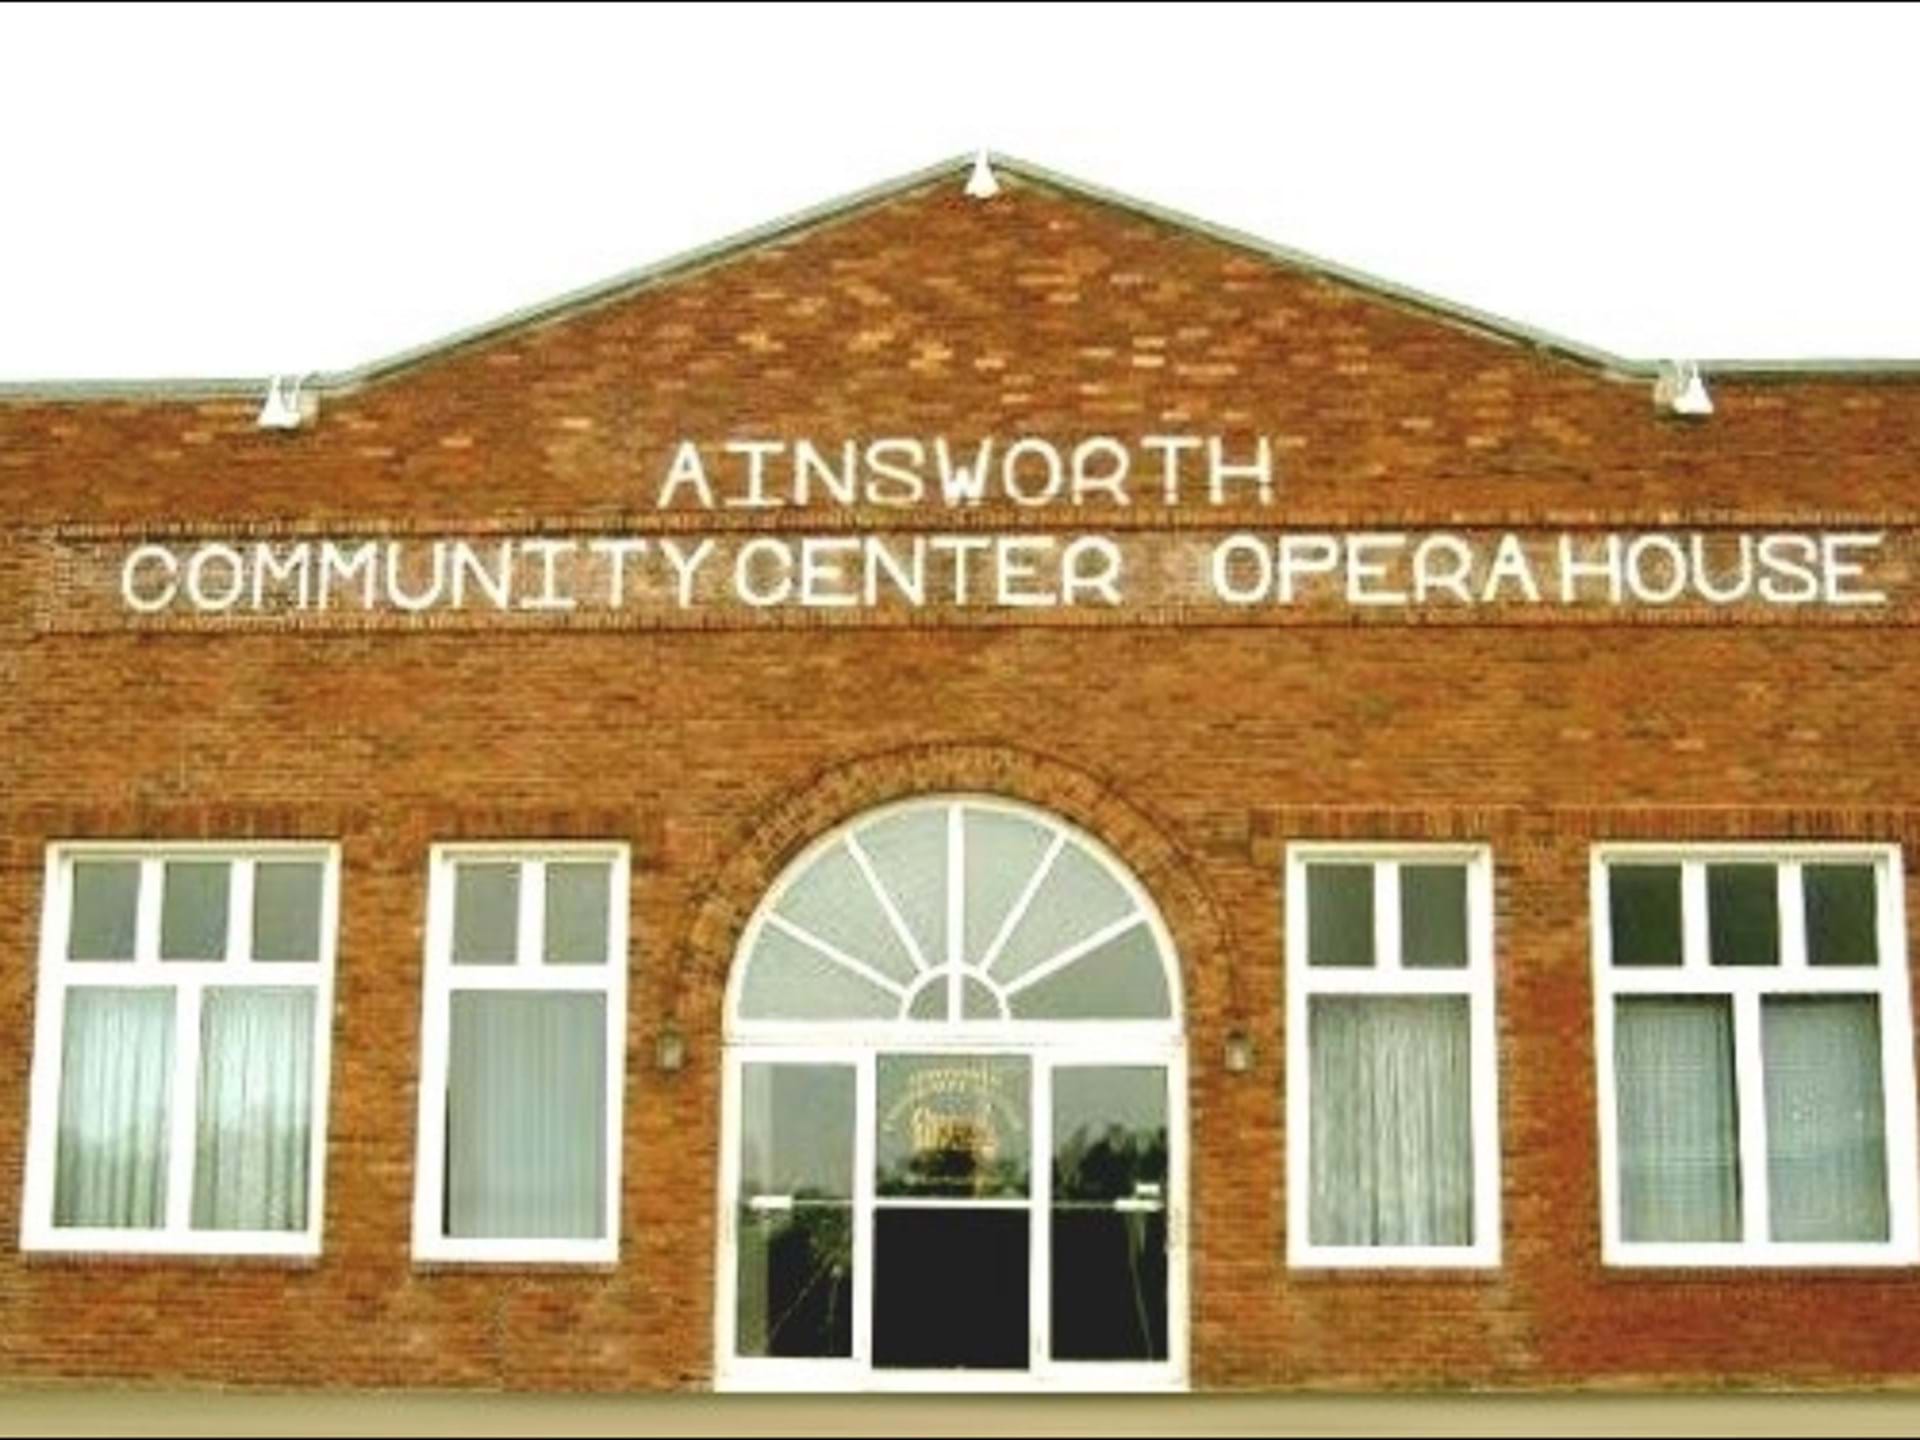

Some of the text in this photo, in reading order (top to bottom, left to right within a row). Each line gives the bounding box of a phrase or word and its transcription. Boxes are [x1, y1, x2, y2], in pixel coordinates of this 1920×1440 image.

[656, 435, 1275, 508] AINSWORTH
[120, 529, 1888, 612] COMMUNITY CENTER OPERA HOUSE
